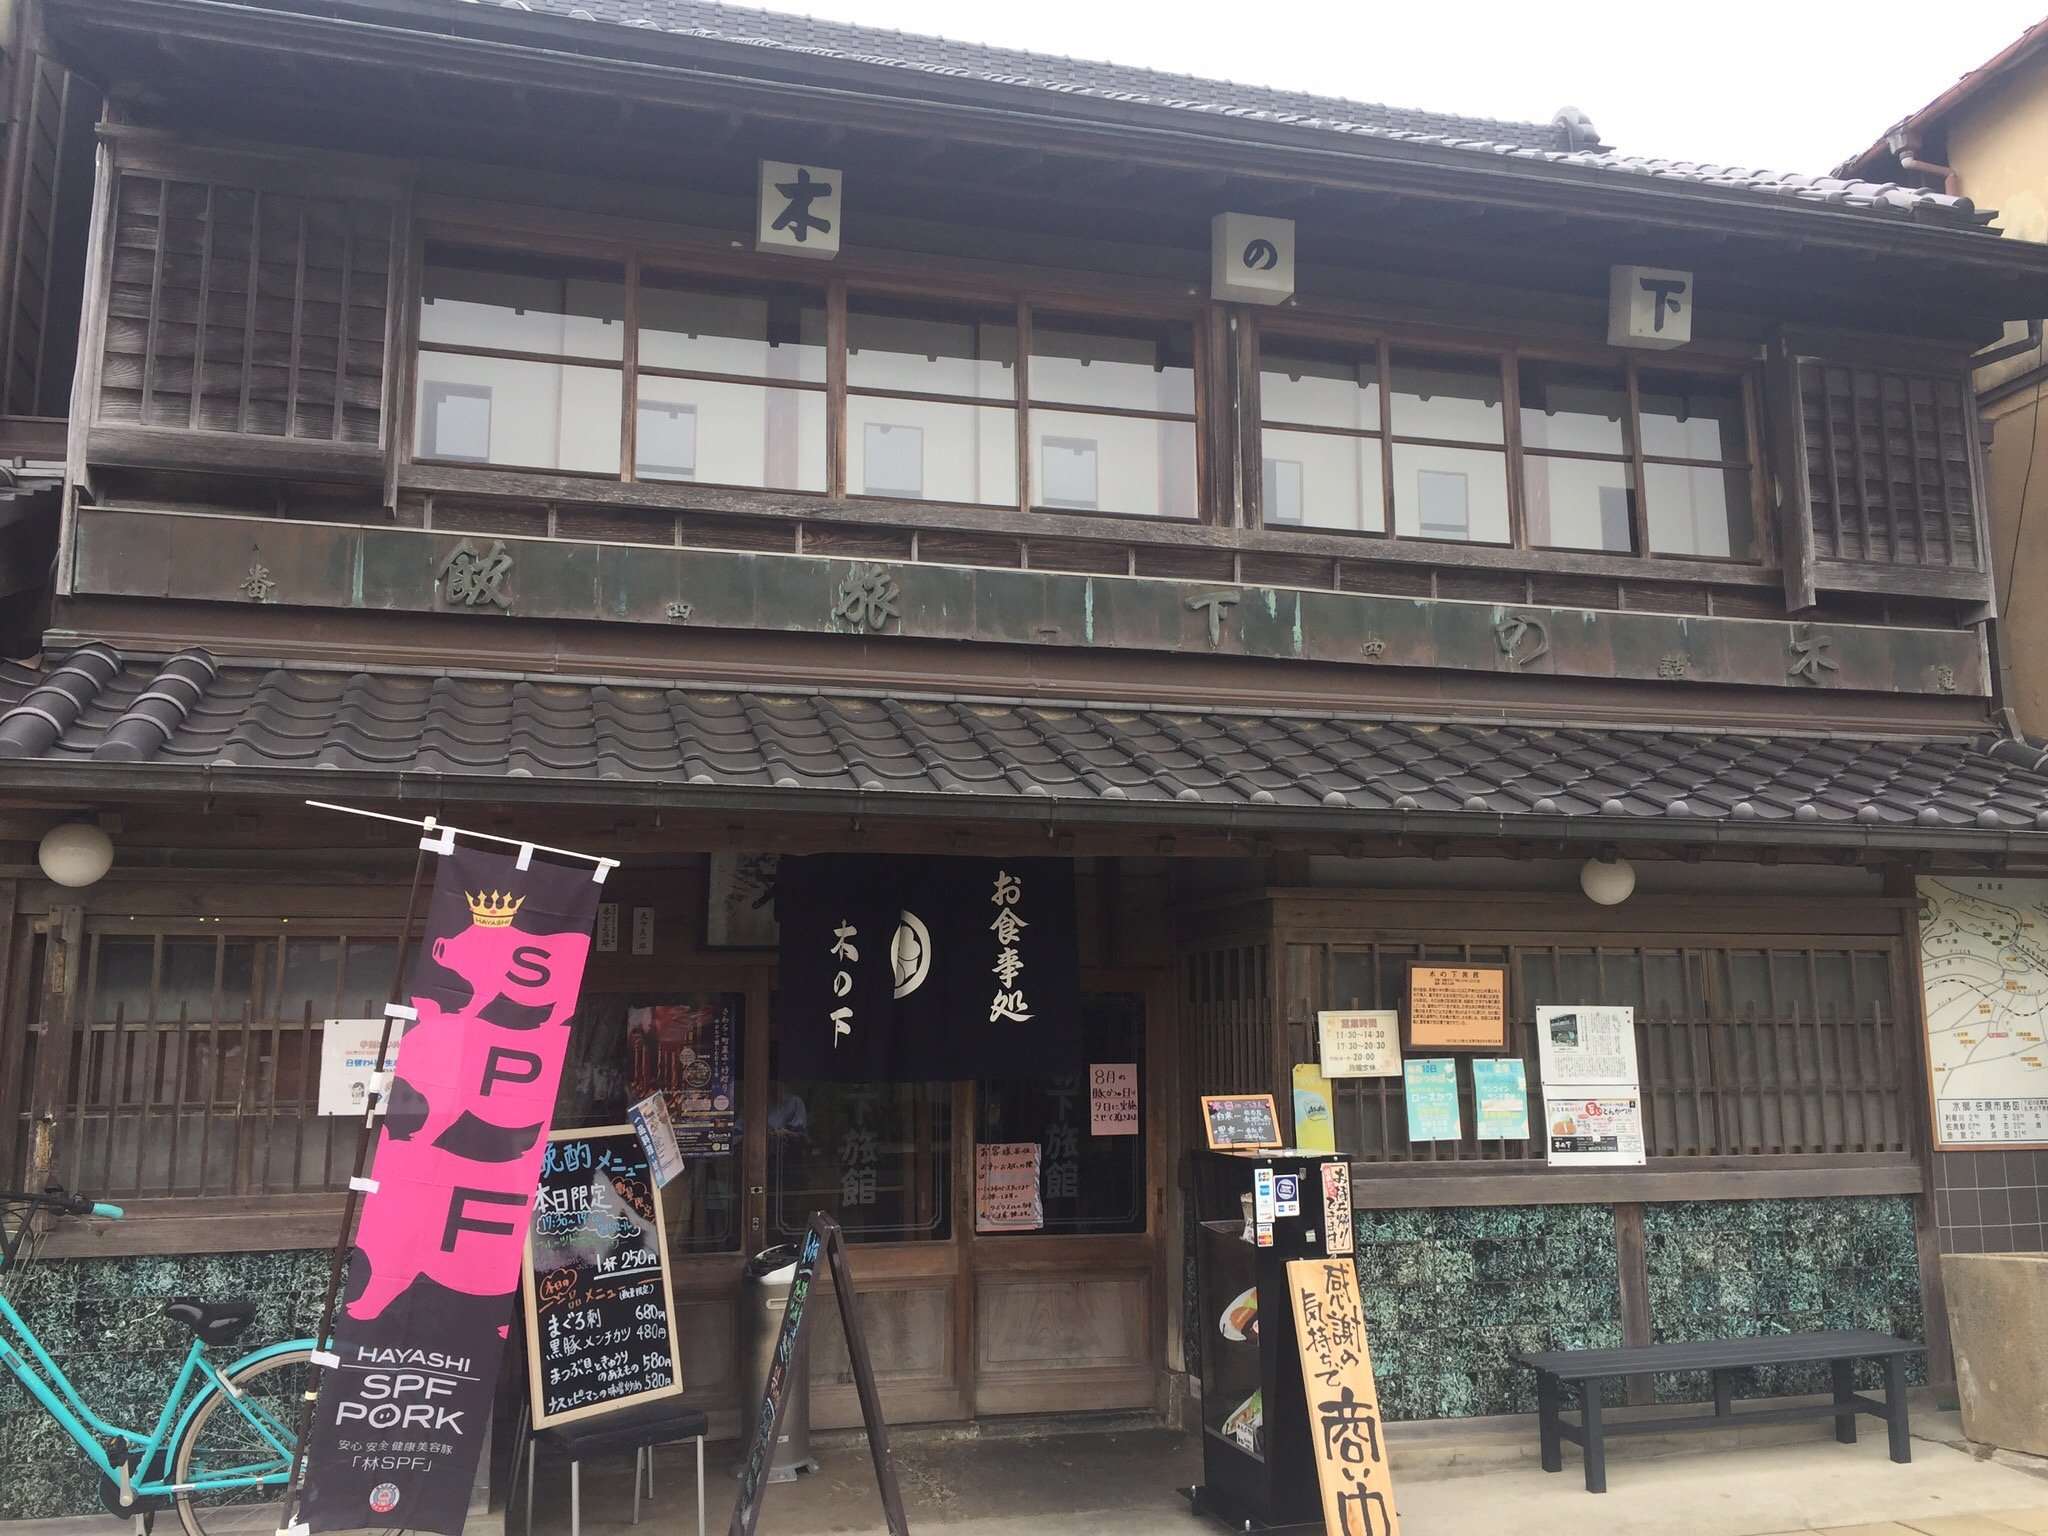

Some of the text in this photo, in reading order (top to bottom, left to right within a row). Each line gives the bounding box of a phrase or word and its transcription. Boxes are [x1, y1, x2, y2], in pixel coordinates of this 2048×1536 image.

[772, 168, 1689, 333] 木 の 下
[239, 563, 277, 600] 番
[1187, 588, 1241, 648] 下
[1496, 614, 1551, 665] の
[1789, 635, 1840, 685] 木
[475, 917, 511, 927] HAYASHI
[989, 870, 1036, 1023] お食事処
[829, 918, 860, 1049] 木の下
[1341, 1018, 1378, 1029] 営業時間
[1094, 1069, 1126, 1085] 8月の
[1307, 1104, 1326, 1114] Asahi
[533, 1181, 613, 1214] 本日限定
[547, 1303, 667, 1340] まぐろ刺 680円
[1323, 1262, 1362, 1367] 感謝の
[635, 1322, 668, 1342] 480円
[1301, 1287, 1344, 1388] 気持ちで
[357, 1345, 471, 1373] HAYASHI
[642, 1351, 673, 1373] 580円
[359, 1373, 458, 1400] SPF
[335, 1401, 465, 1436] PORK
[337, 1439, 454, 1456] 安心 安全 健康美容豚
[351, 1455, 433, 1473] 「林SPF」
